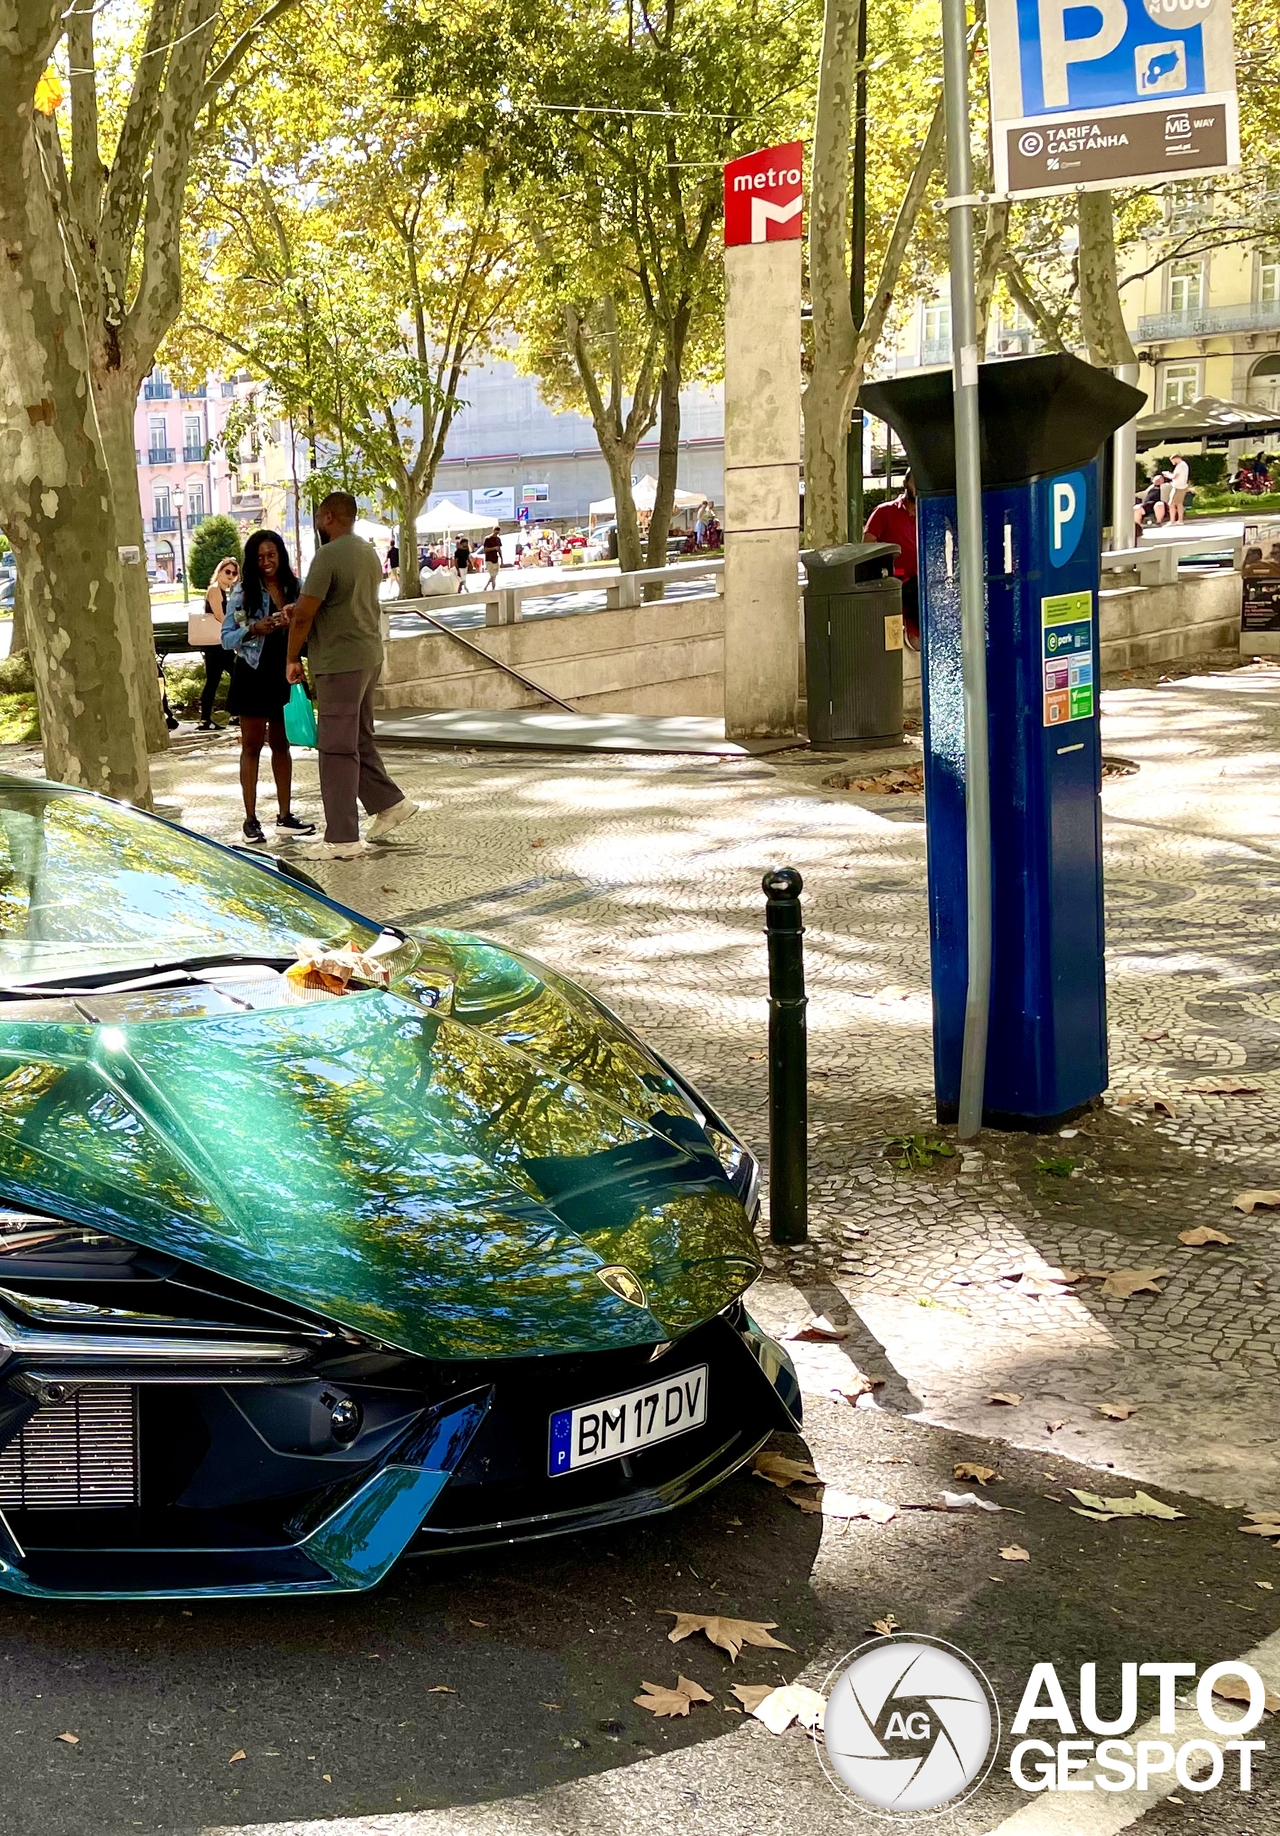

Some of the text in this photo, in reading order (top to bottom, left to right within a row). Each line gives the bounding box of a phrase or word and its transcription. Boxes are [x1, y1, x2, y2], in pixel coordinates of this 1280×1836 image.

[1038, 0, 1128, 108] P
[1047, 124, 1101, 141] TARIFA
[1165, 118, 1215, 135] MB WAY
[1047, 133, 1129, 154] CASTANHA
[733, 167, 801, 192] metro
[1053, 483, 1076, 549] P
[578, 1377, 702, 1457] BM 17 DV
[558, 1451, 566, 1465] P
